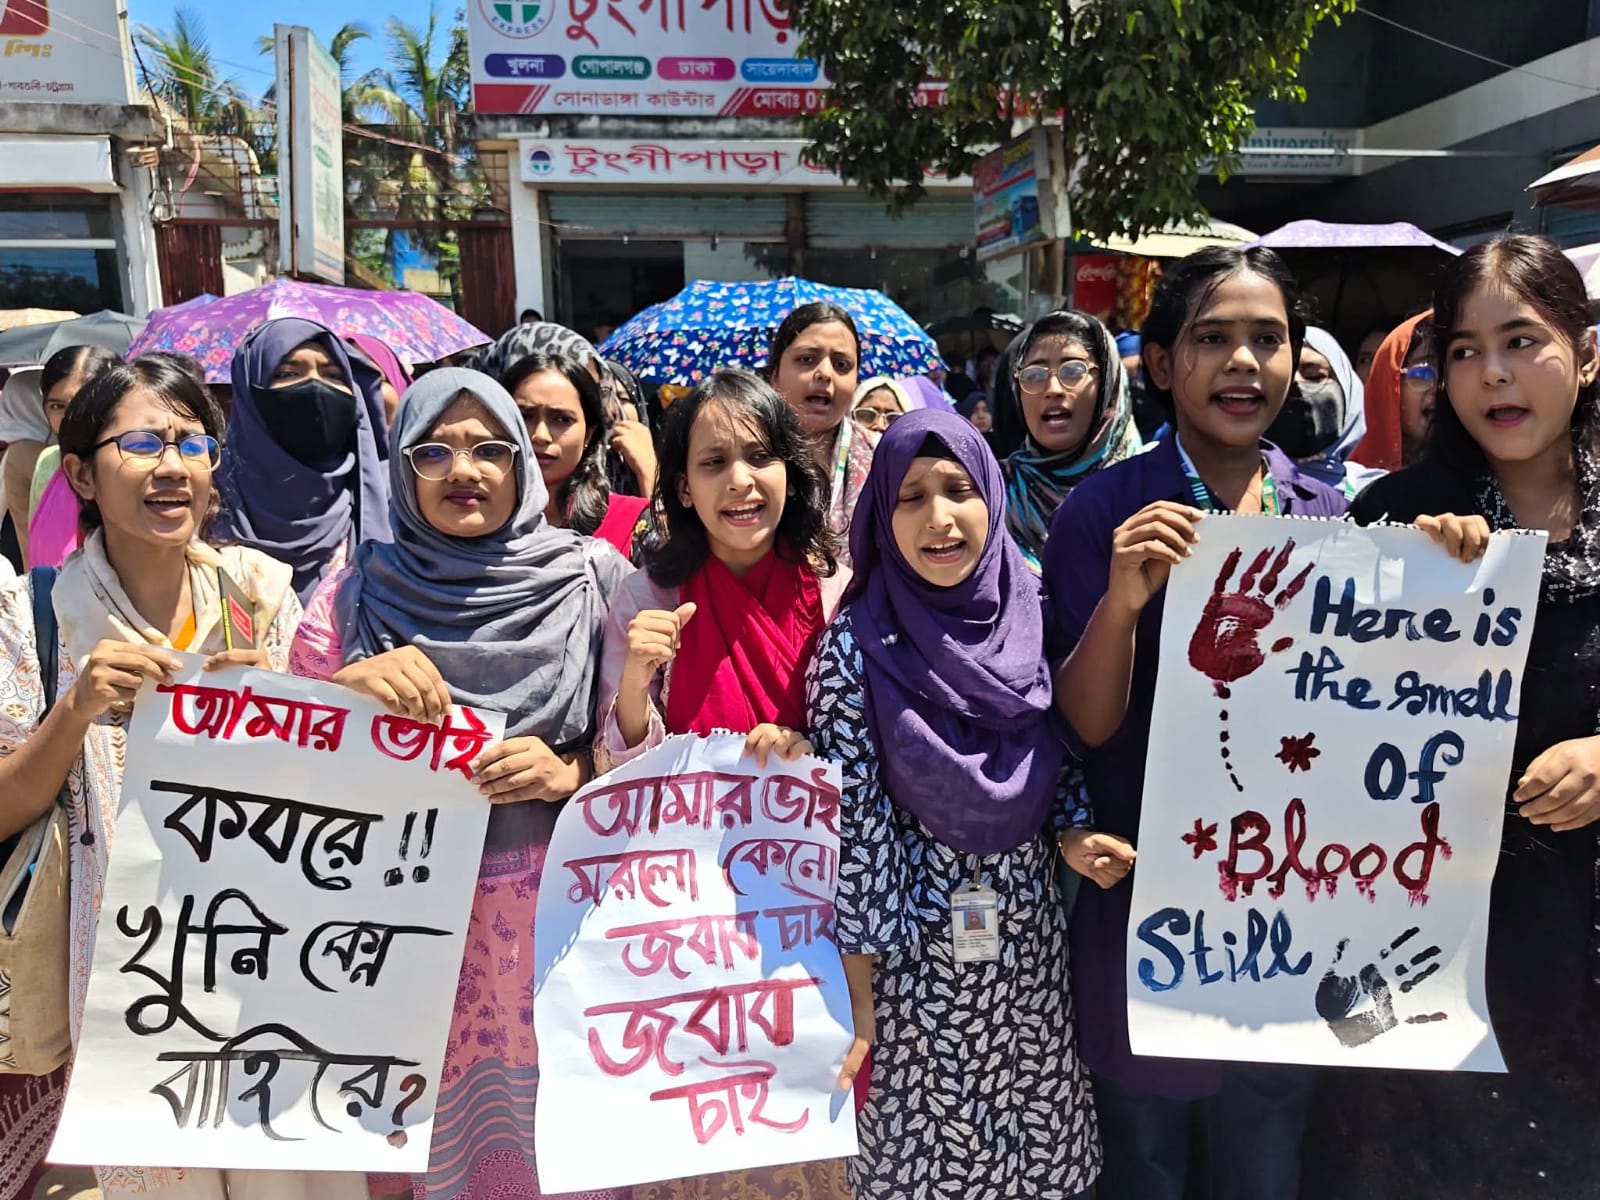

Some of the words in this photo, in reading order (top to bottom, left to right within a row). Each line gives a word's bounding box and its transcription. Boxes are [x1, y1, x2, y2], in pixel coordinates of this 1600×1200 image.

[491, 15, 546, 35] EXPRESS
[507, 57, 545, 76] খুলনা
[579, 60, 645, 76] গোপালগঞ্জ
[645, 89, 717, 109] কাউন্টার
[678, 61, 716, 76] ঢাকা
[745, 62, 815, 77] সায়েদাবাদ
[564, 144, 789, 176] টুংগীপাড়া
[1309, 575, 1462, 643] Here
[1472, 587, 1523, 647] is
[1284, 645, 1382, 711] the
[156, 683, 351, 752] আমার
[370, 705, 494, 781] ভাই
[575, 770, 759, 838] আমার
[760, 767, 841, 837] ভাই
[562, 848, 700, 907] মরলো
[722, 838, 838, 896] কেনো
[1218, 798, 1452, 905] Blood
[116, 888, 290, 1042] খুনি
[1136, 907, 1313, 993] Still
[583, 976, 828, 1077] জবাব
[650, 1055, 810, 1145] চাই
